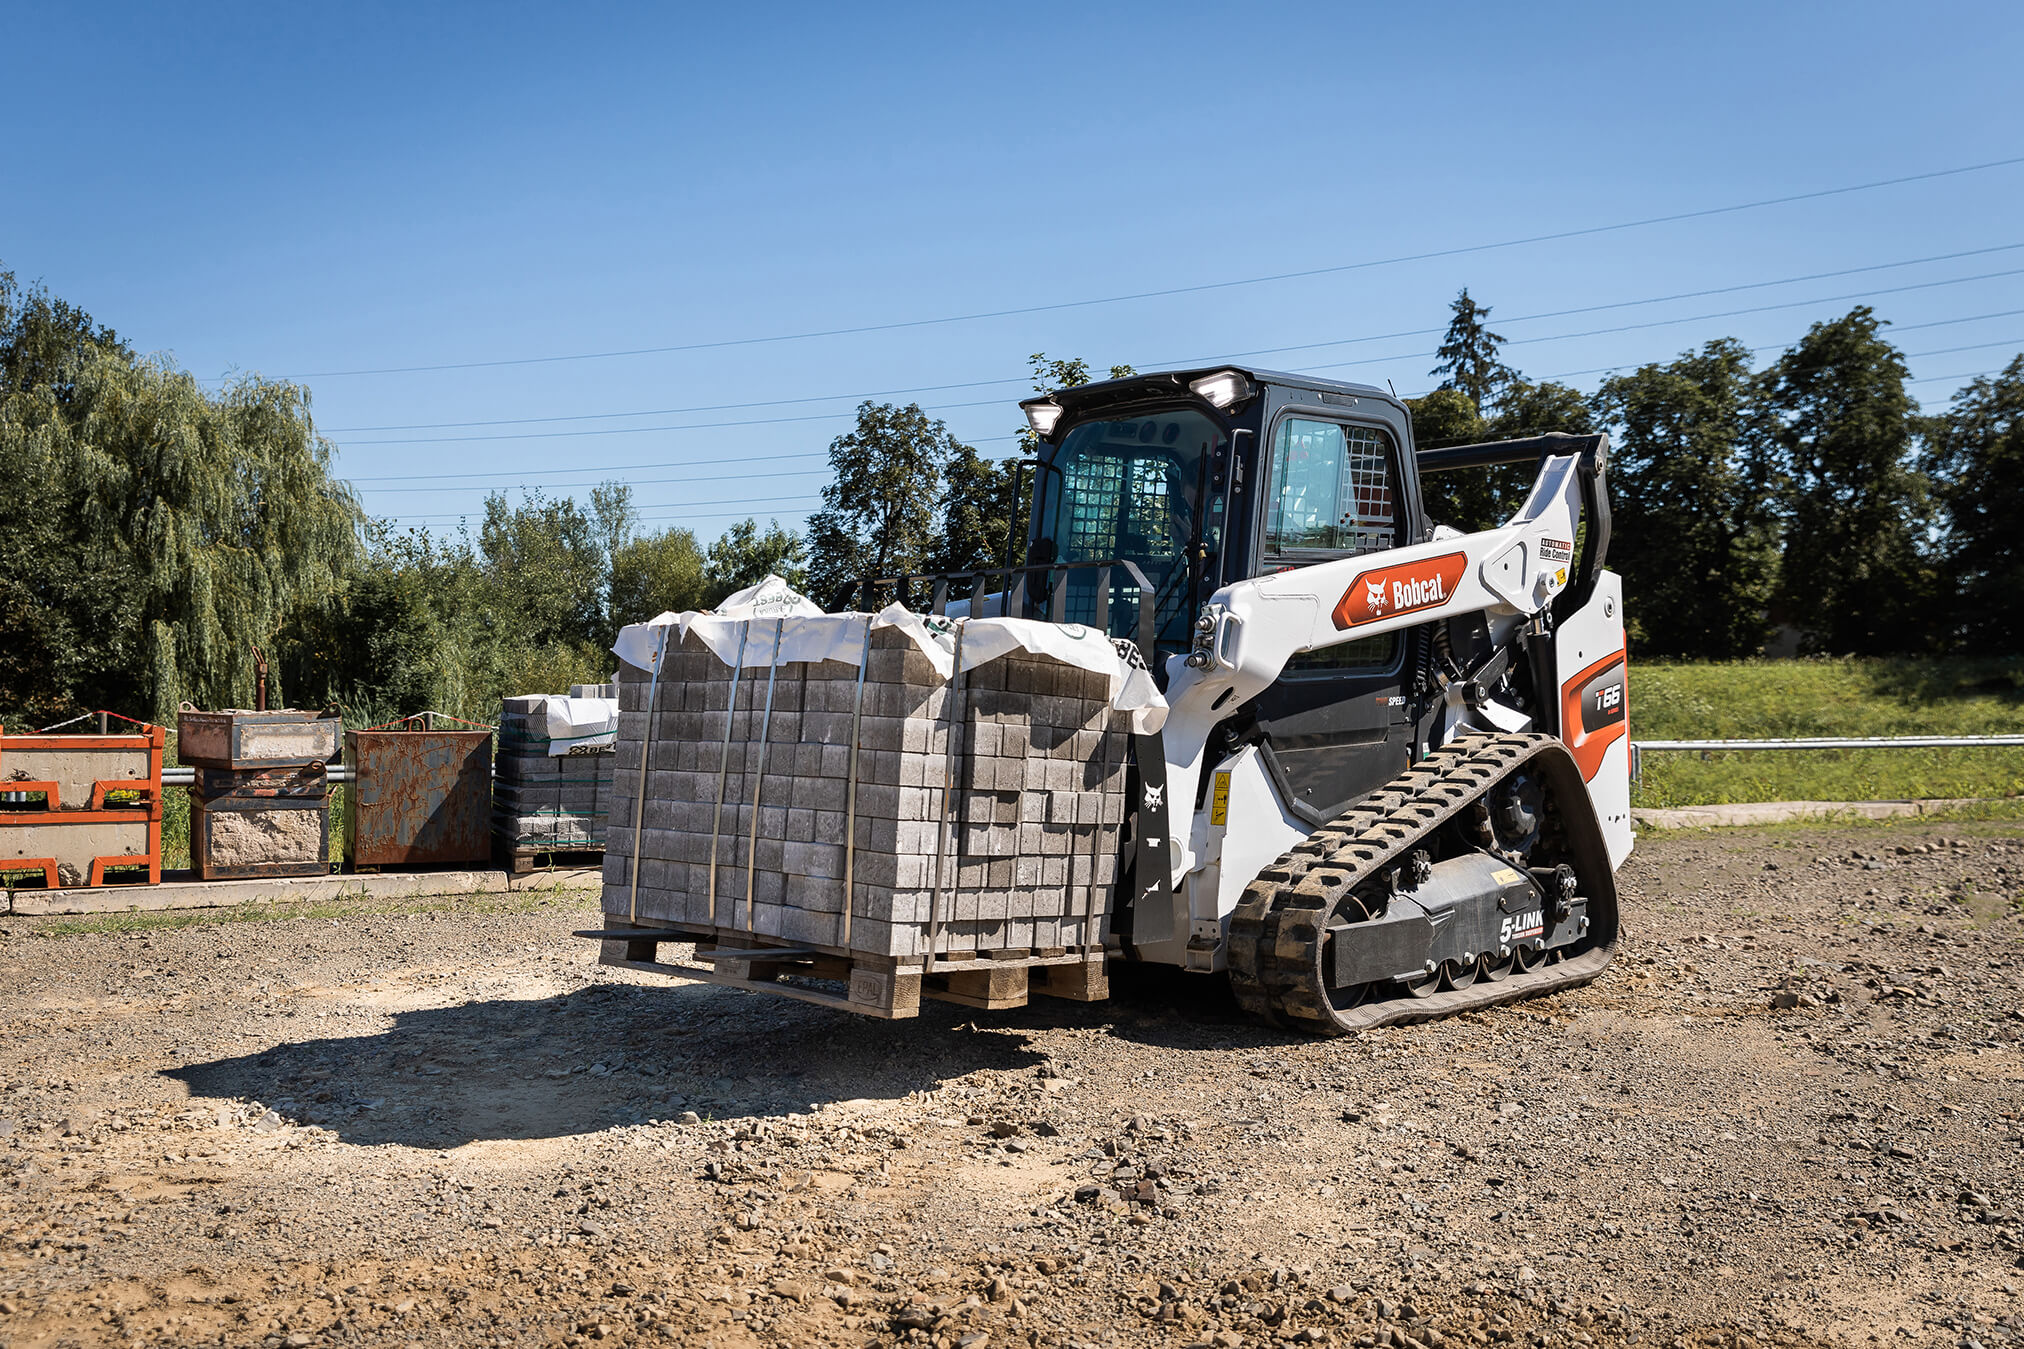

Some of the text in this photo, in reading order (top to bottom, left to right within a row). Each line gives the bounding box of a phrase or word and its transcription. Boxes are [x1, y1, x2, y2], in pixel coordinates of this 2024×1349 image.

[1540, 547, 1571, 561] Ride Control
[1541, 538, 1571, 550] AUTOMATIC
[1392, 573, 1444, 610] Bobcat
[1388, 696, 1406, 706] SPEED
[1595, 683, 1621, 711] T66
[1499, 909, 1544, 943] 5-LINK
